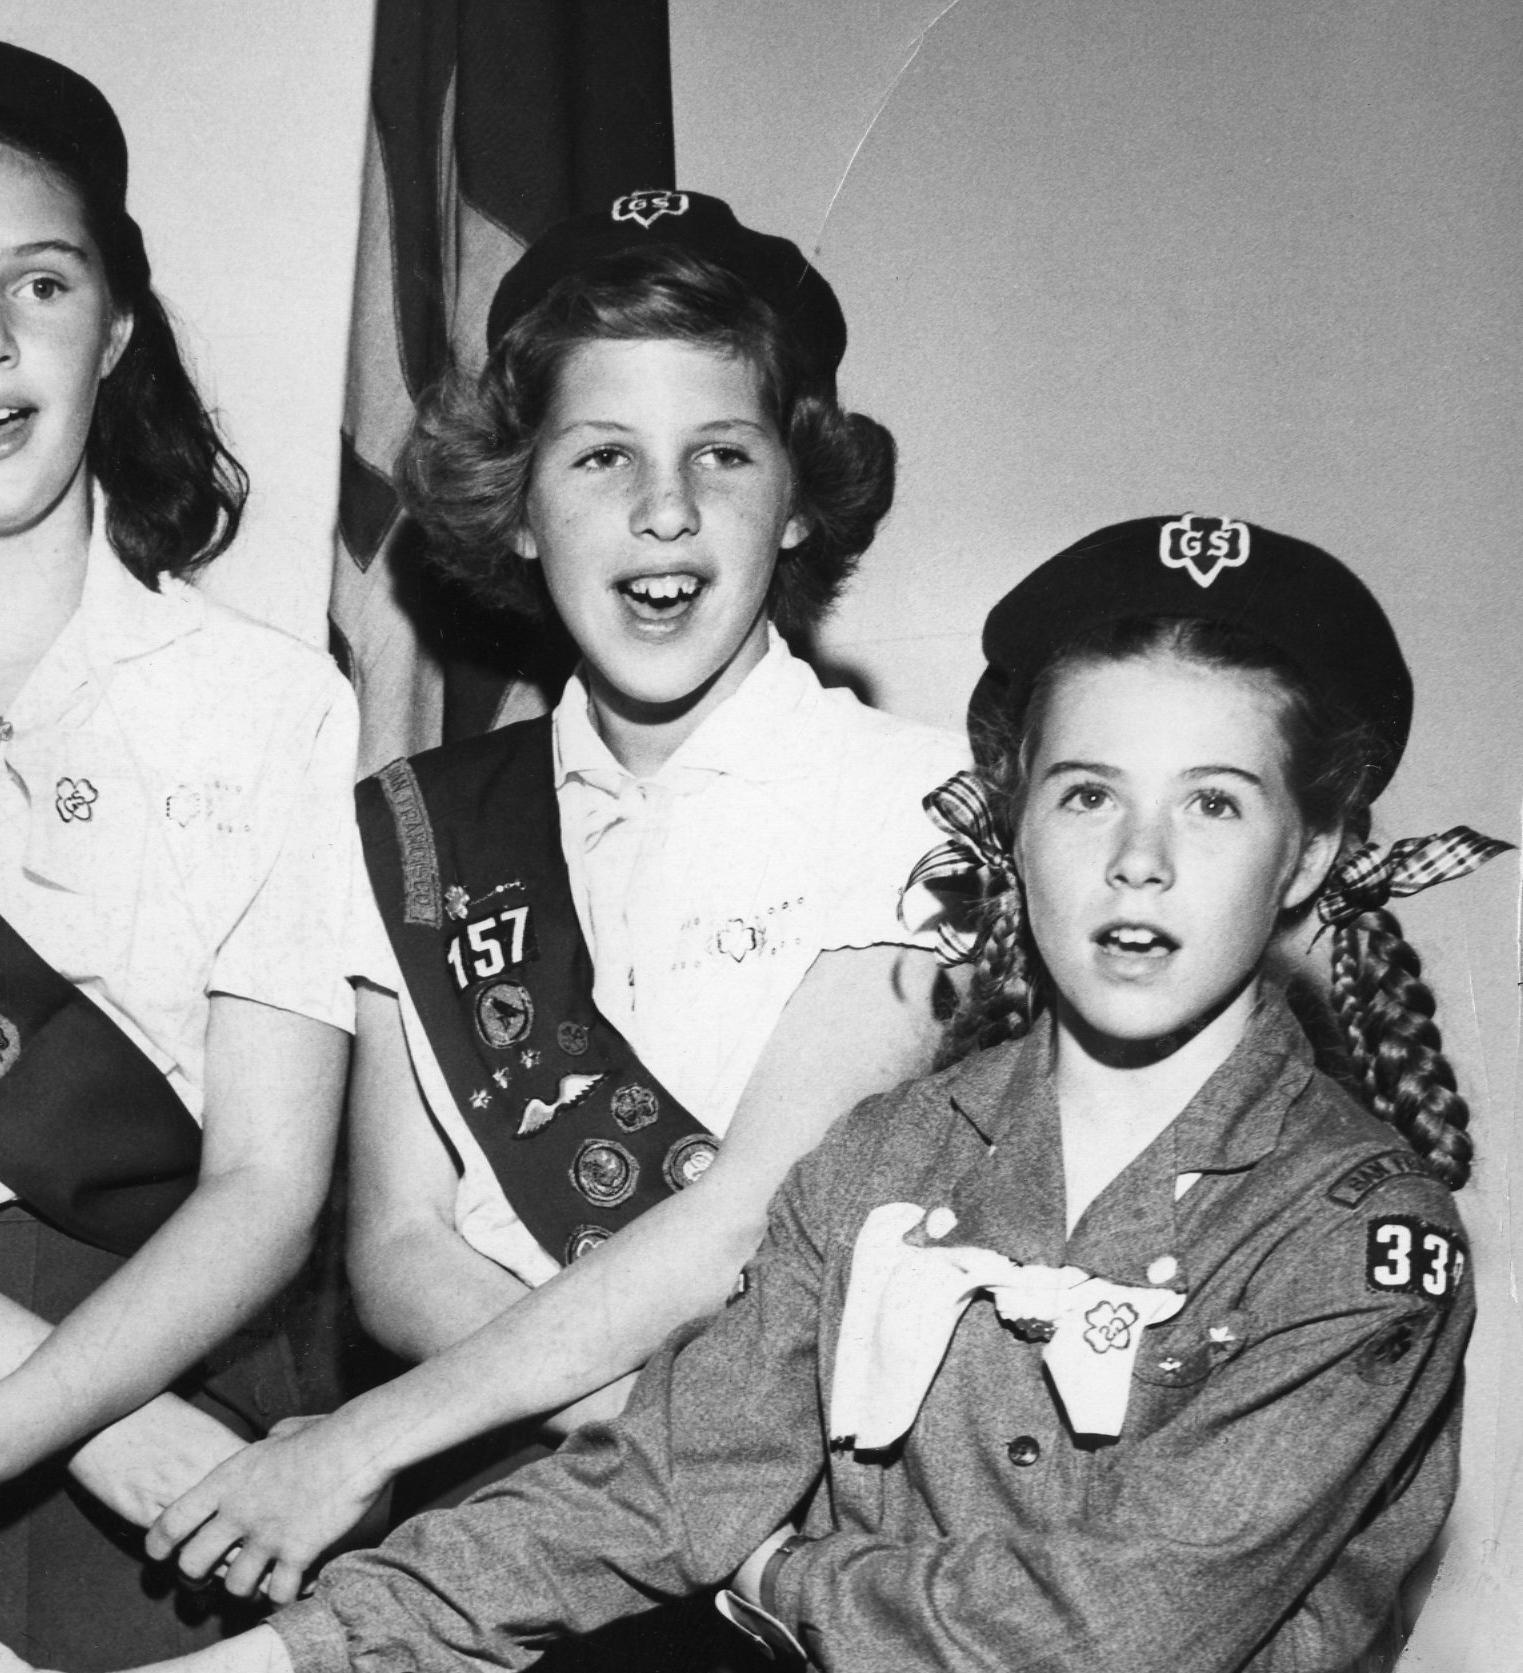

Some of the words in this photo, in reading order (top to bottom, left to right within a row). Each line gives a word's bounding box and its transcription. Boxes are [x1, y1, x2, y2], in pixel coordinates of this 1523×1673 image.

[628, 198, 669, 211] GS
[1180, 530, 1232, 557] GS
[447, 906, 529, 988] 157
[1348, 1161, 1391, 1192] SAN
